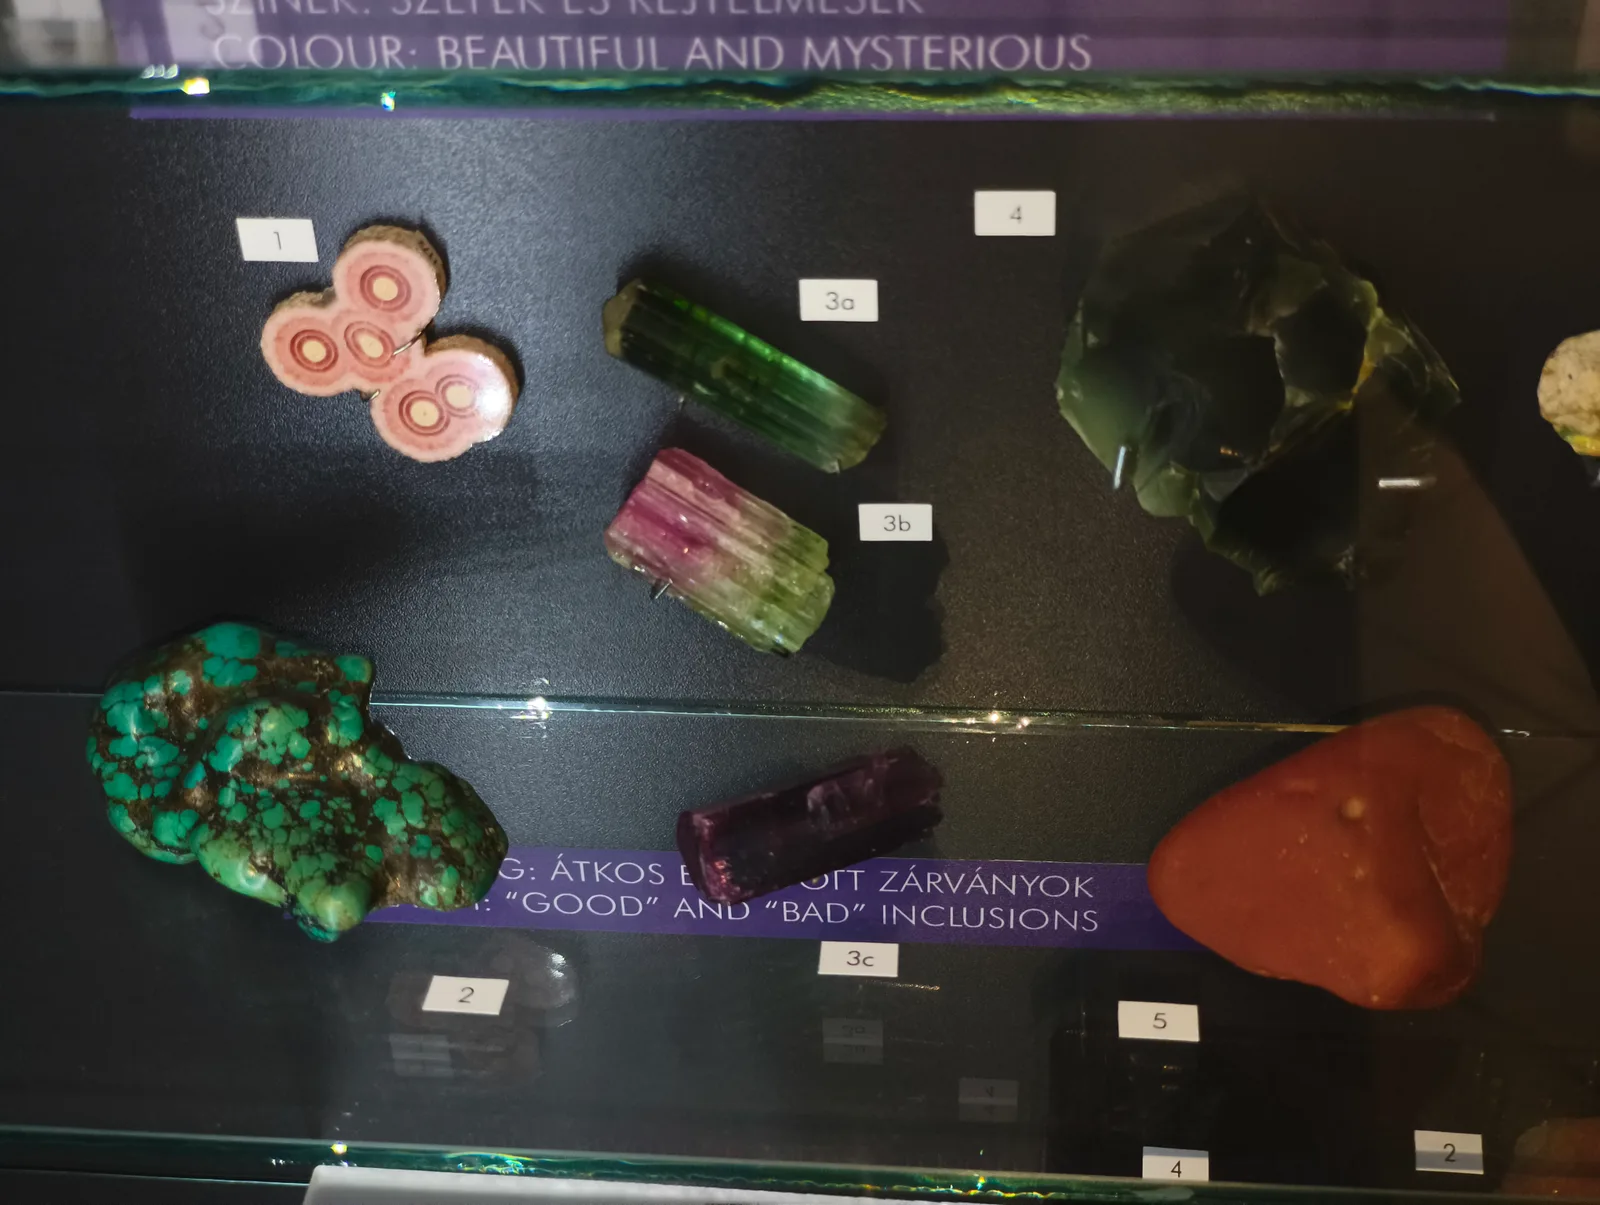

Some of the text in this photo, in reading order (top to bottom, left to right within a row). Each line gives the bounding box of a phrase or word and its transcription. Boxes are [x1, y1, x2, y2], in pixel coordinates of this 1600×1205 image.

[437, 35, 669, 71] BEAUTIFUL
[684, 36, 785, 71] AND
[803, 34, 1092, 71] MYSTERIOUS
[1009, 204, 1022, 225] 4
[273, 231, 282, 251] 1
[825, 291, 855, 311] 3a
[883, 514, 911, 532] 3b
[550, 853, 665, 885] ÁTKOS
[878, 864, 1094, 898] ZÁRVÁNYOK
[673, 897, 751, 920] AND
[882, 904, 1099, 932] INCLUSIONS
[846, 950, 875, 967] 3c
[458, 986, 475, 1004] 2
[1152, 1012, 1168, 1030] 5
[1443, 1143, 1456, 1163] 2
[1170, 1160, 1182, 1178] 4
